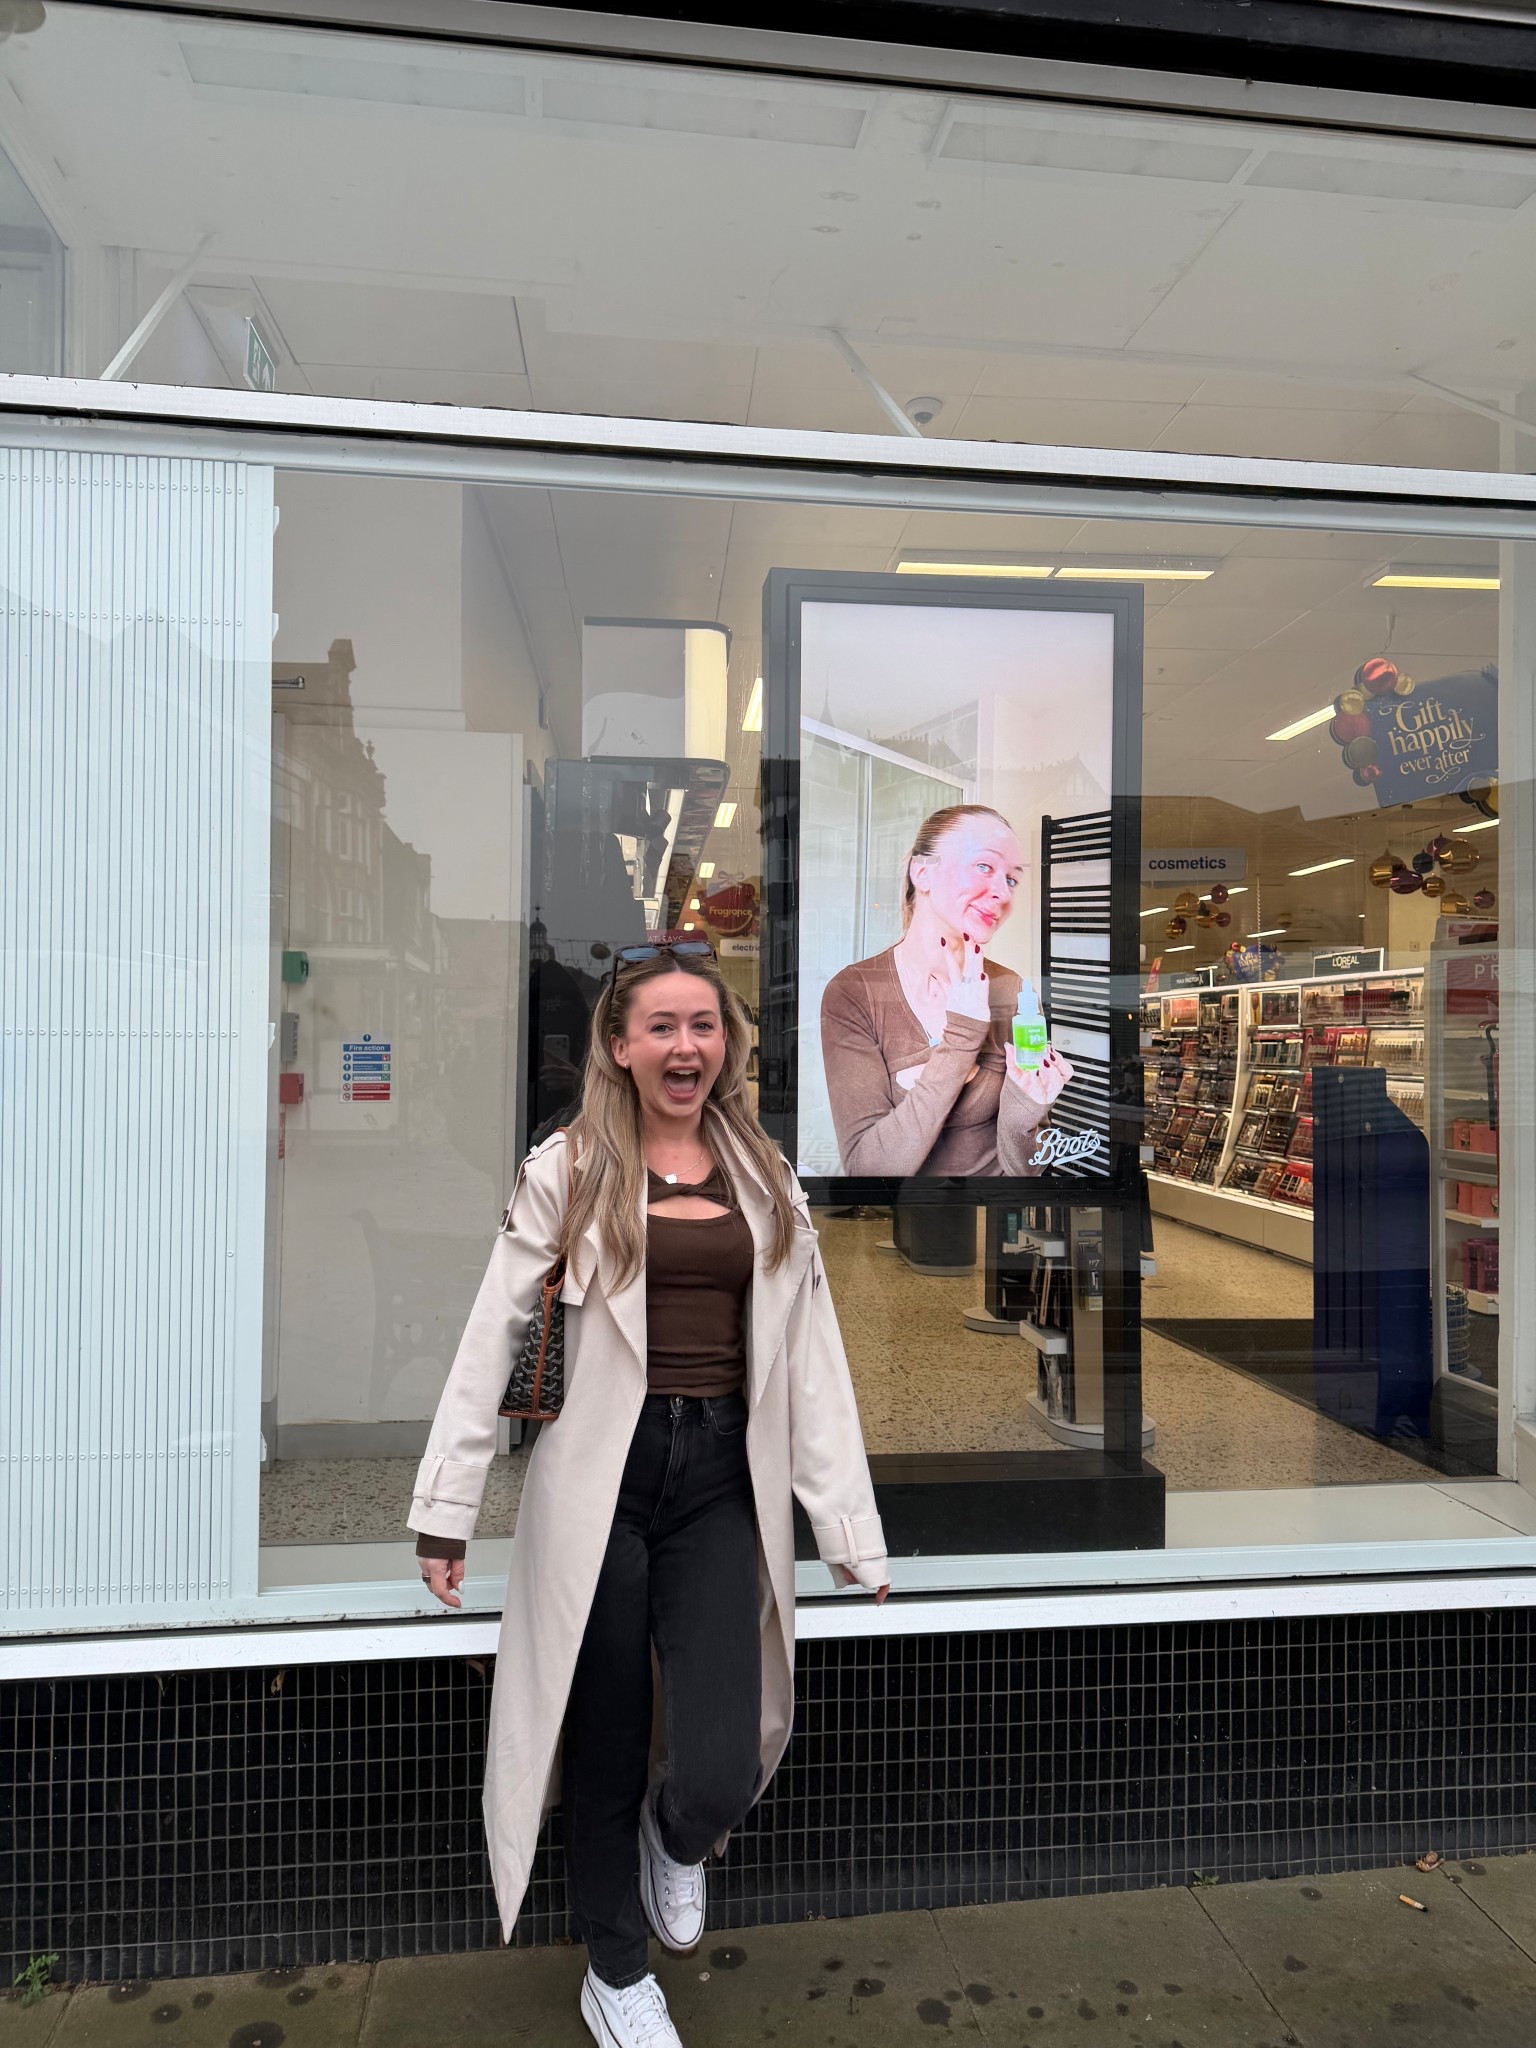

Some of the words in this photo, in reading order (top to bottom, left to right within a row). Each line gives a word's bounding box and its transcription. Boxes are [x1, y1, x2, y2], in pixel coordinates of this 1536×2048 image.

[1380, 697, 1447, 732] Gift
[1387, 709, 1485, 756] happily
[1400, 755, 1431, 775] ever
[1426, 749, 1469, 784] after
[1148, 855, 1227, 870] cosmetics
[709, 905, 753, 918] Fragrance
[1028, 1128, 1101, 1167] Boots
